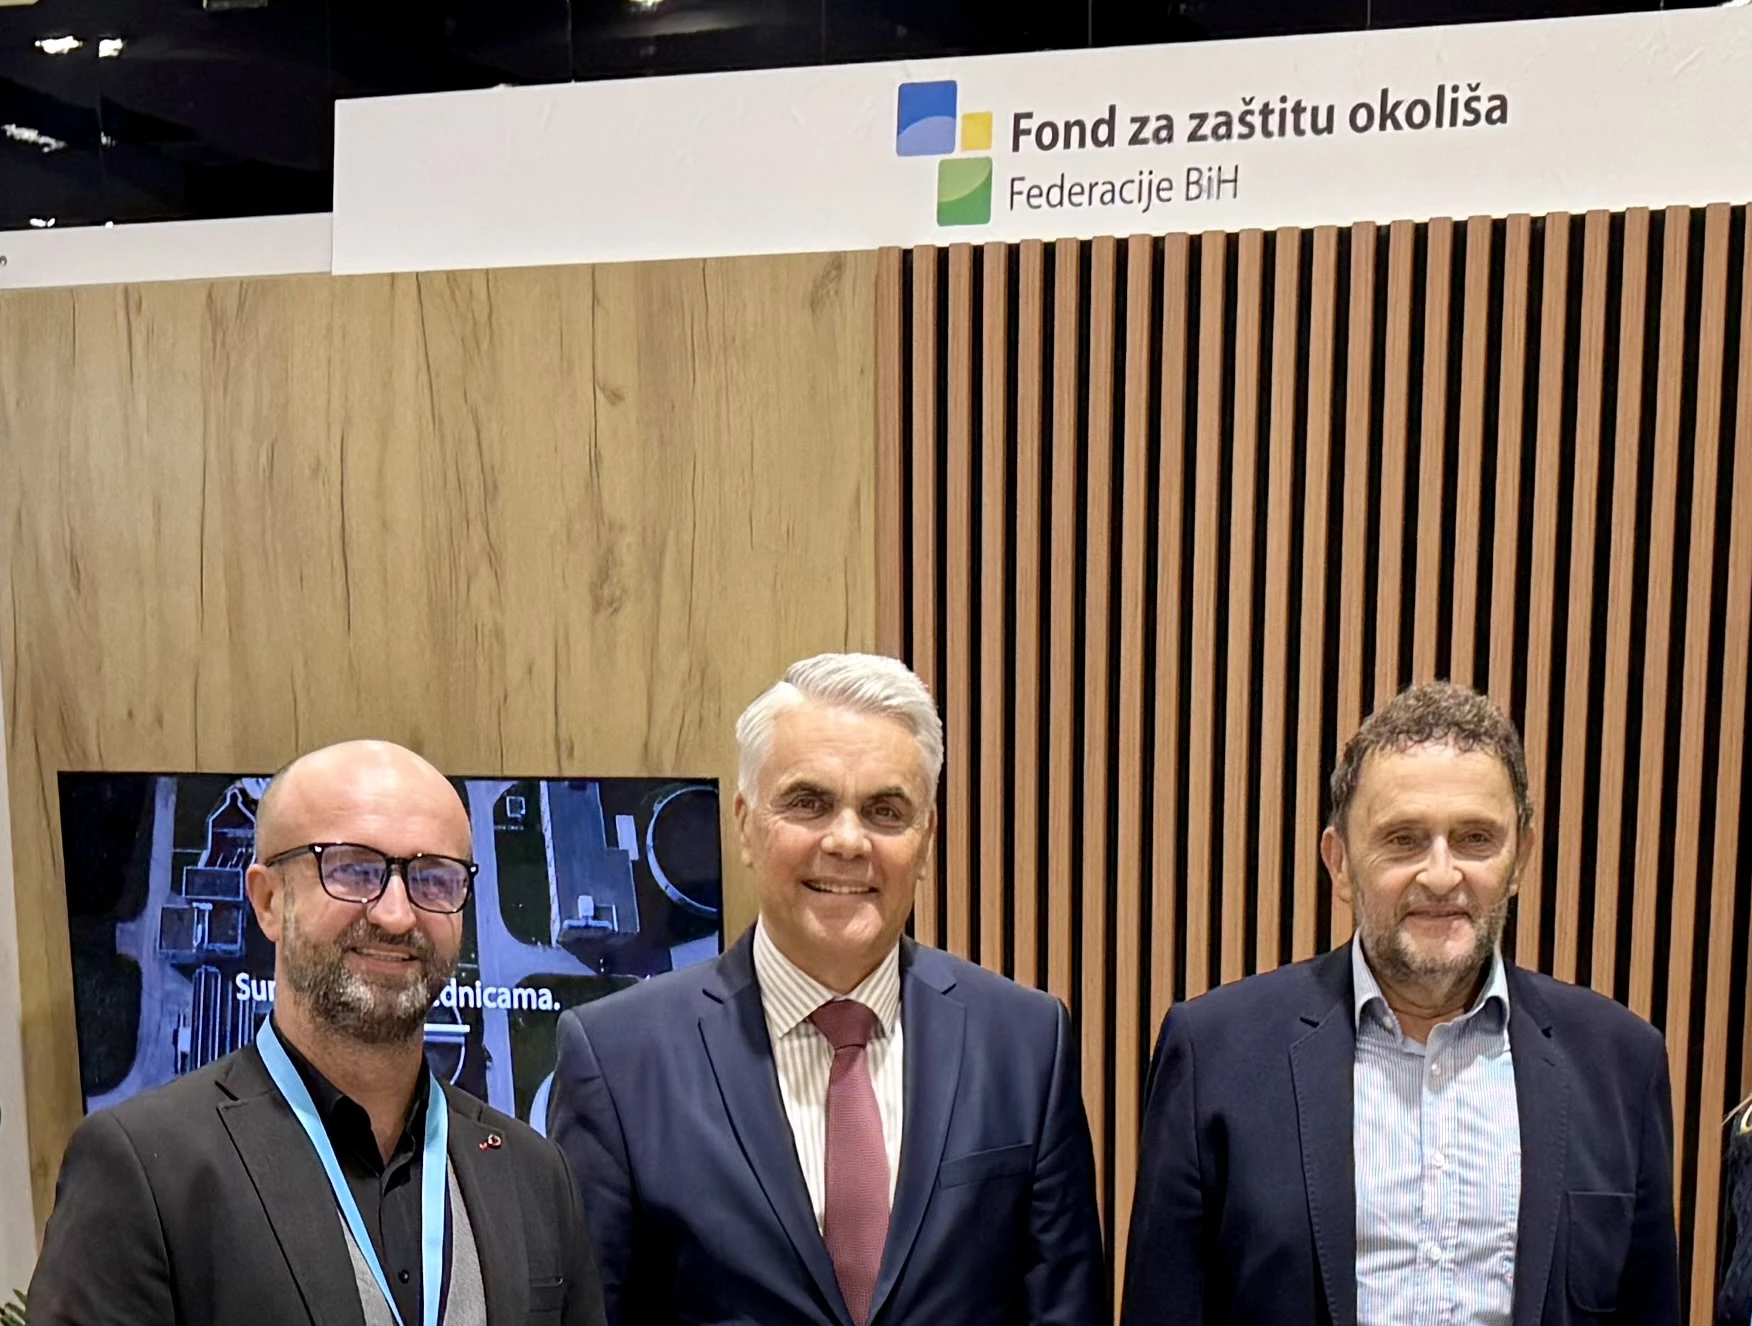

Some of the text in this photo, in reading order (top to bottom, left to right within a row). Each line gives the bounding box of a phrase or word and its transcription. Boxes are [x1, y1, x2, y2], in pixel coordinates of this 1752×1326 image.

[1012, 82, 1508, 153] Fond za zaštitu okoliša
[1010, 164, 1239, 214] Federacije BiH
[432, 978, 560, 1011] dnicama.
